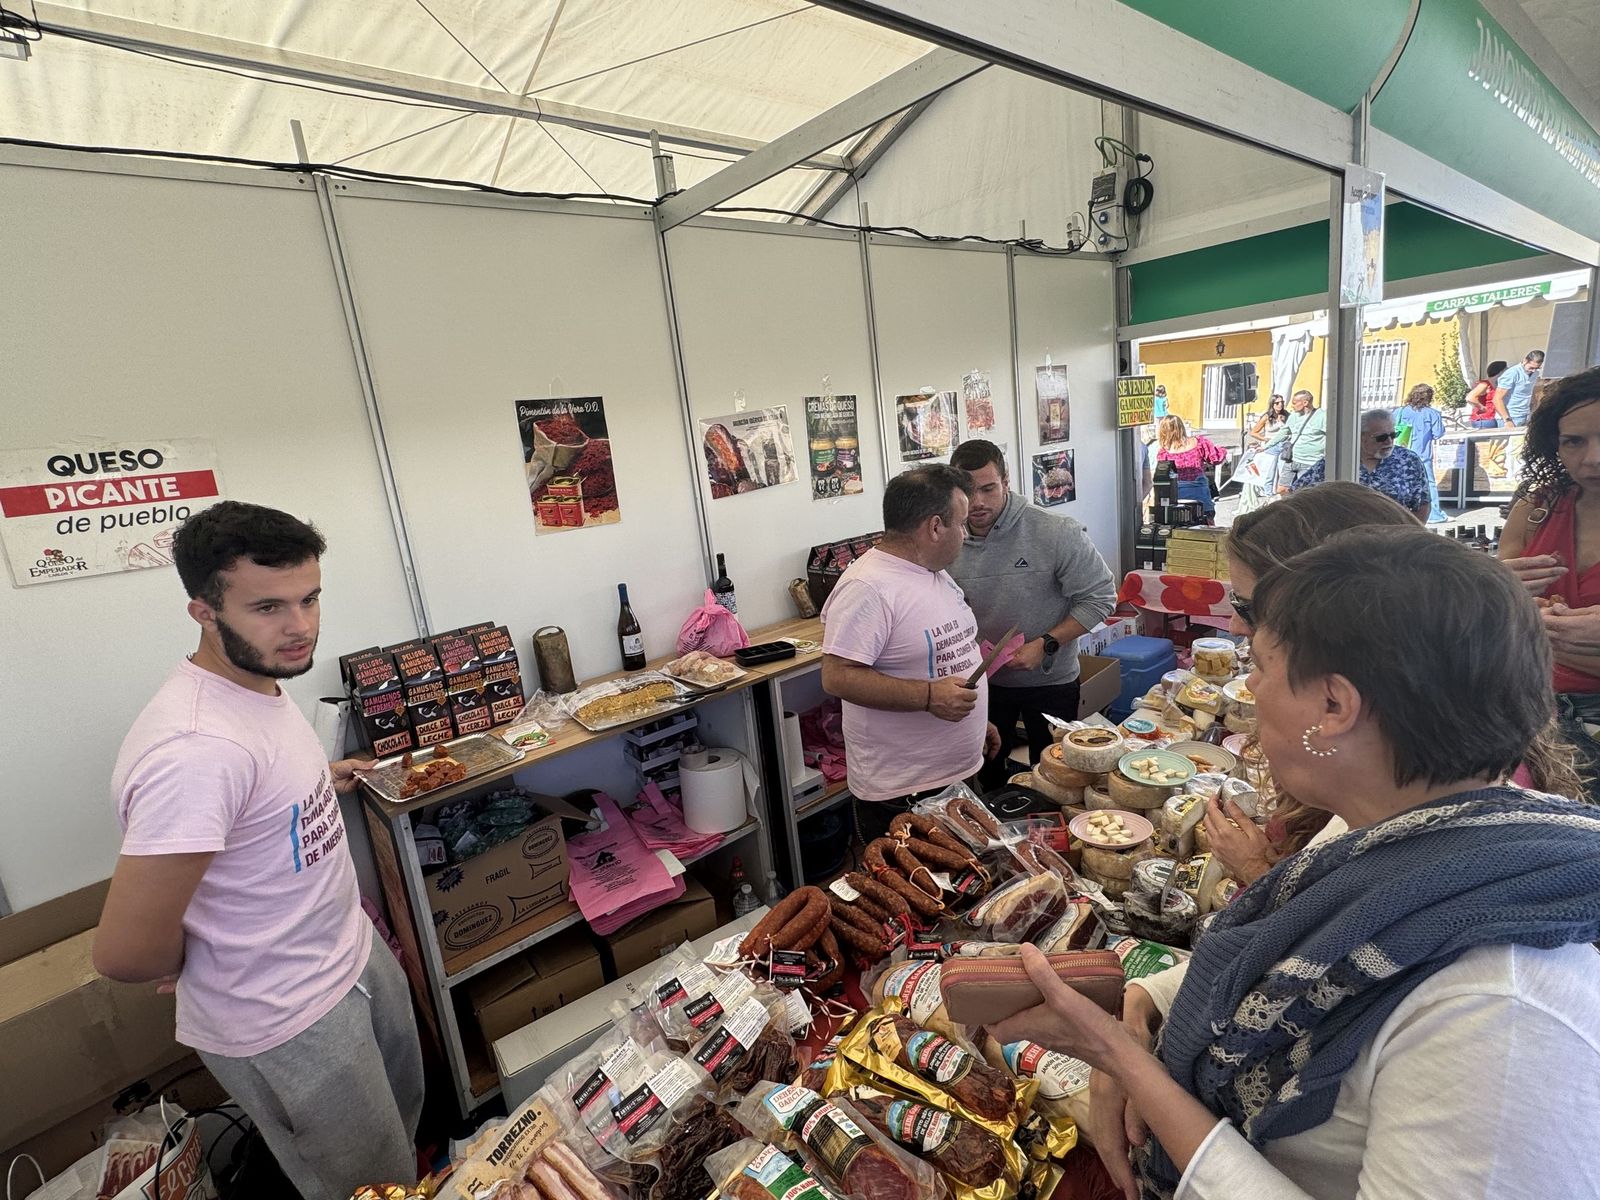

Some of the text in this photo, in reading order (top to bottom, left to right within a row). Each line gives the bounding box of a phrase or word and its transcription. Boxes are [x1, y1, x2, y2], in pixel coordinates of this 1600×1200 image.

[1433, 285, 1541, 311] CARPAS TALLERES
[1118, 378, 1154, 396] SE VENDEN
[520, 405, 550, 416] Pimentón
[837, 400, 854, 411] QUESO
[47, 448, 164, 477] QUESO
[44, 477, 181, 510] PICANTE
[56, 505, 190, 535] de pueblo
[29, 561, 88, 577] EMPERADOR
[480, 630, 501, 641] PELIGRO
[932, 627, 942, 638] LA
[942, 621, 954, 634] VIDA
[442, 639, 466, 650] PELIGRO
[478, 636, 509, 649] GAMUSINOS
[936, 632, 964, 651] DEMASIADO
[402, 649, 426, 662] PELIGRO
[442, 644, 474, 660] GAMUSINOS
[936, 651, 956, 664] PARA
[358, 658, 384, 670] PELIGRO
[400, 654, 435, 670] GAMUSINOS
[486, 661, 516, 674] GAMUSINOS
[356, 663, 392, 680] GAMUSINOS
[448, 670, 481, 686] GAMUSINOS
[937, 666, 948, 678] DE
[408, 681, 443, 696] GAMUSINOS
[364, 690, 401, 707] GAMUSINOS
[494, 700, 510, 710] DULCE
[459, 708, 487, 721] CHOCOLATE
[420, 719, 449, 734] DULCE DE
[461, 719, 488, 732] Y CEREZA
[377, 734, 409, 752] CHOCOLATE
[423, 731, 449, 744] LECHE
[303, 794, 314, 812] LA
[302, 821, 328, 848] PARA
[304, 848, 320, 868] DE
[485, 867, 510, 884] FRAGIL
[454, 914, 493, 938] DOMINGUEZ
[1116, 937, 1136, 956] ARCIA
[1023, 1043, 1043, 1065] DEHE
[1039, 1057, 1055, 1074] JAMÓN
[1051, 1060, 1062, 1071] 50%
[772, 1085, 797, 1102] DEHES
[800, 1119, 818, 1136] 100%
[785, 1185, 802, 1200] 100%
